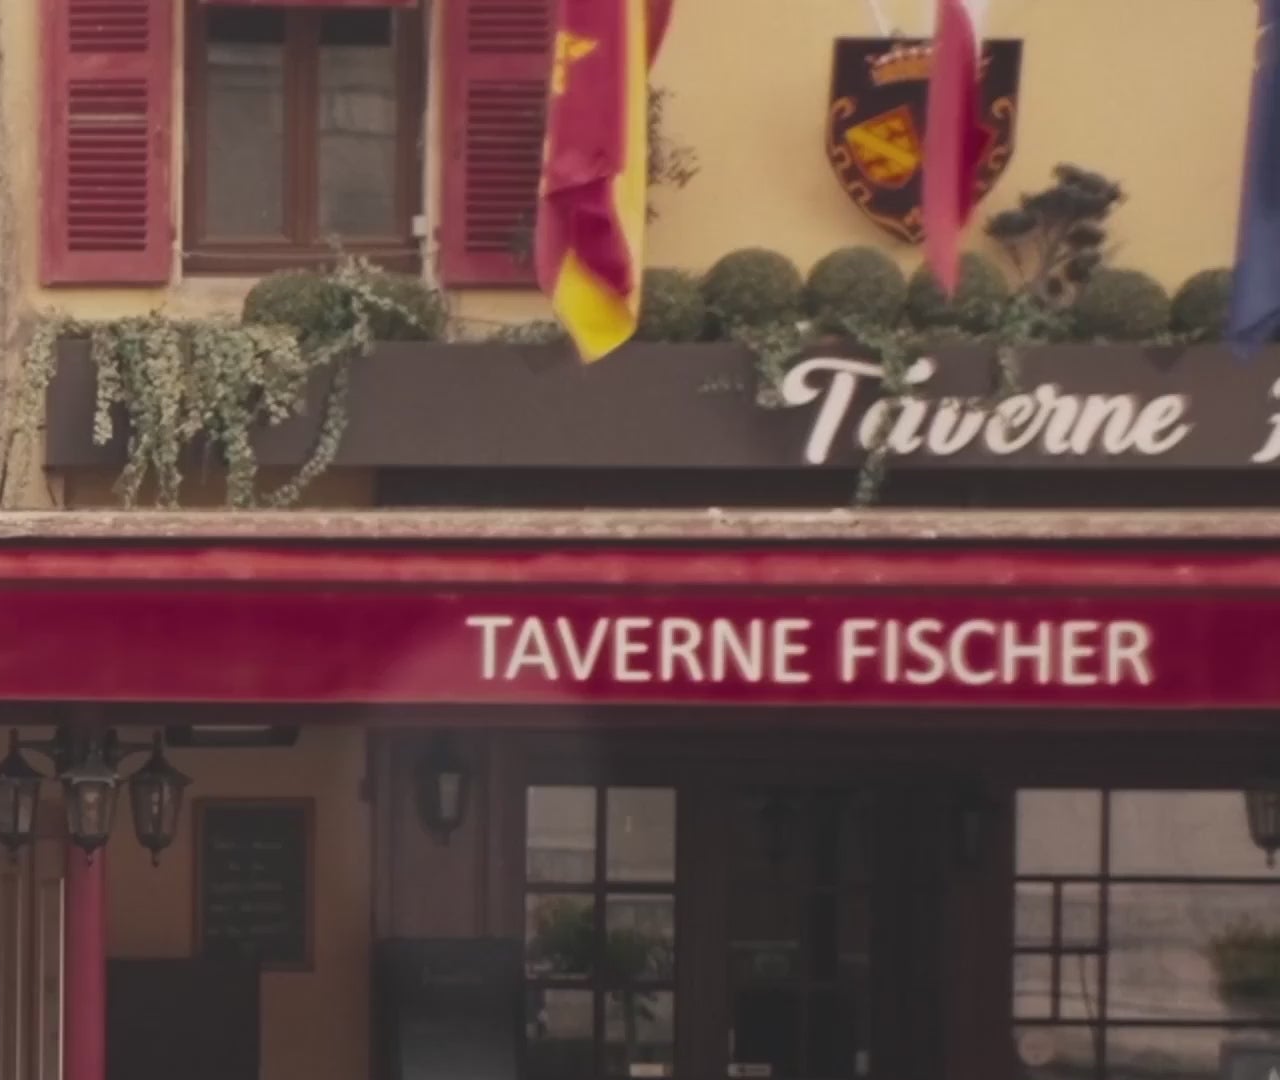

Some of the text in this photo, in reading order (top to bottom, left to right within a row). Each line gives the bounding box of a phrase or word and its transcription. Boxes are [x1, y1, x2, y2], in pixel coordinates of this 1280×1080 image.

[782, 356, 1195, 465] Taverne
[466, 616, 1155, 686] TAVERNE FISCHER
